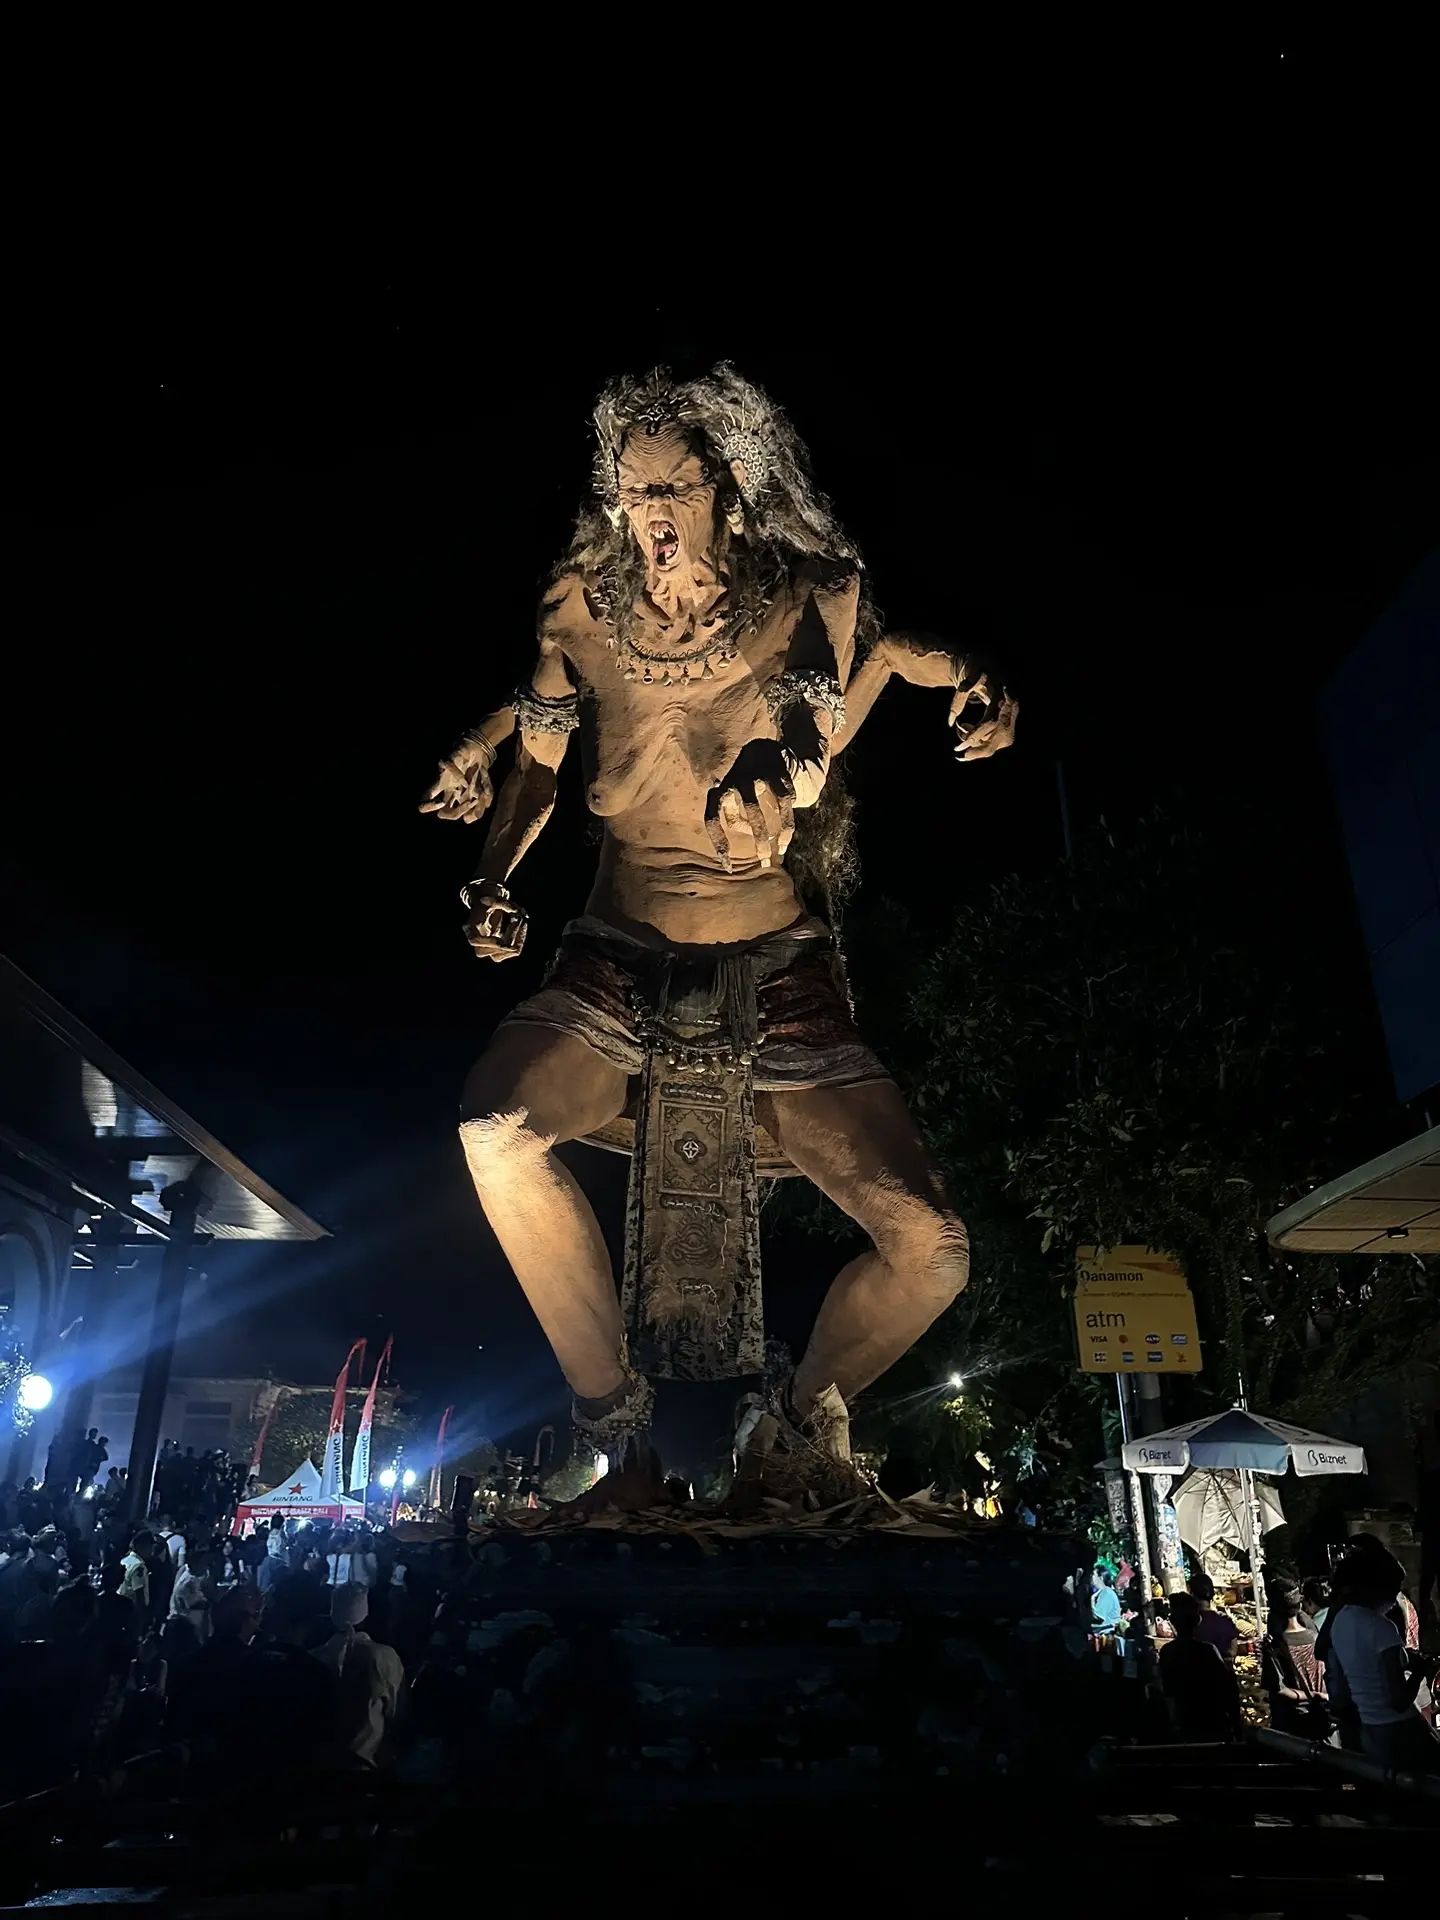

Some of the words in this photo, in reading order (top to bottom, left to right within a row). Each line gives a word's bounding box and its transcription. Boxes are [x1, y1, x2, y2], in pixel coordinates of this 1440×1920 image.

[1080, 1270, 1143, 1281] Danamon
[1086, 1311, 1125, 1328] atm
[1149, 1450, 1171, 1460] Biznet
[1318, 1453, 1347, 1464] Biznet
